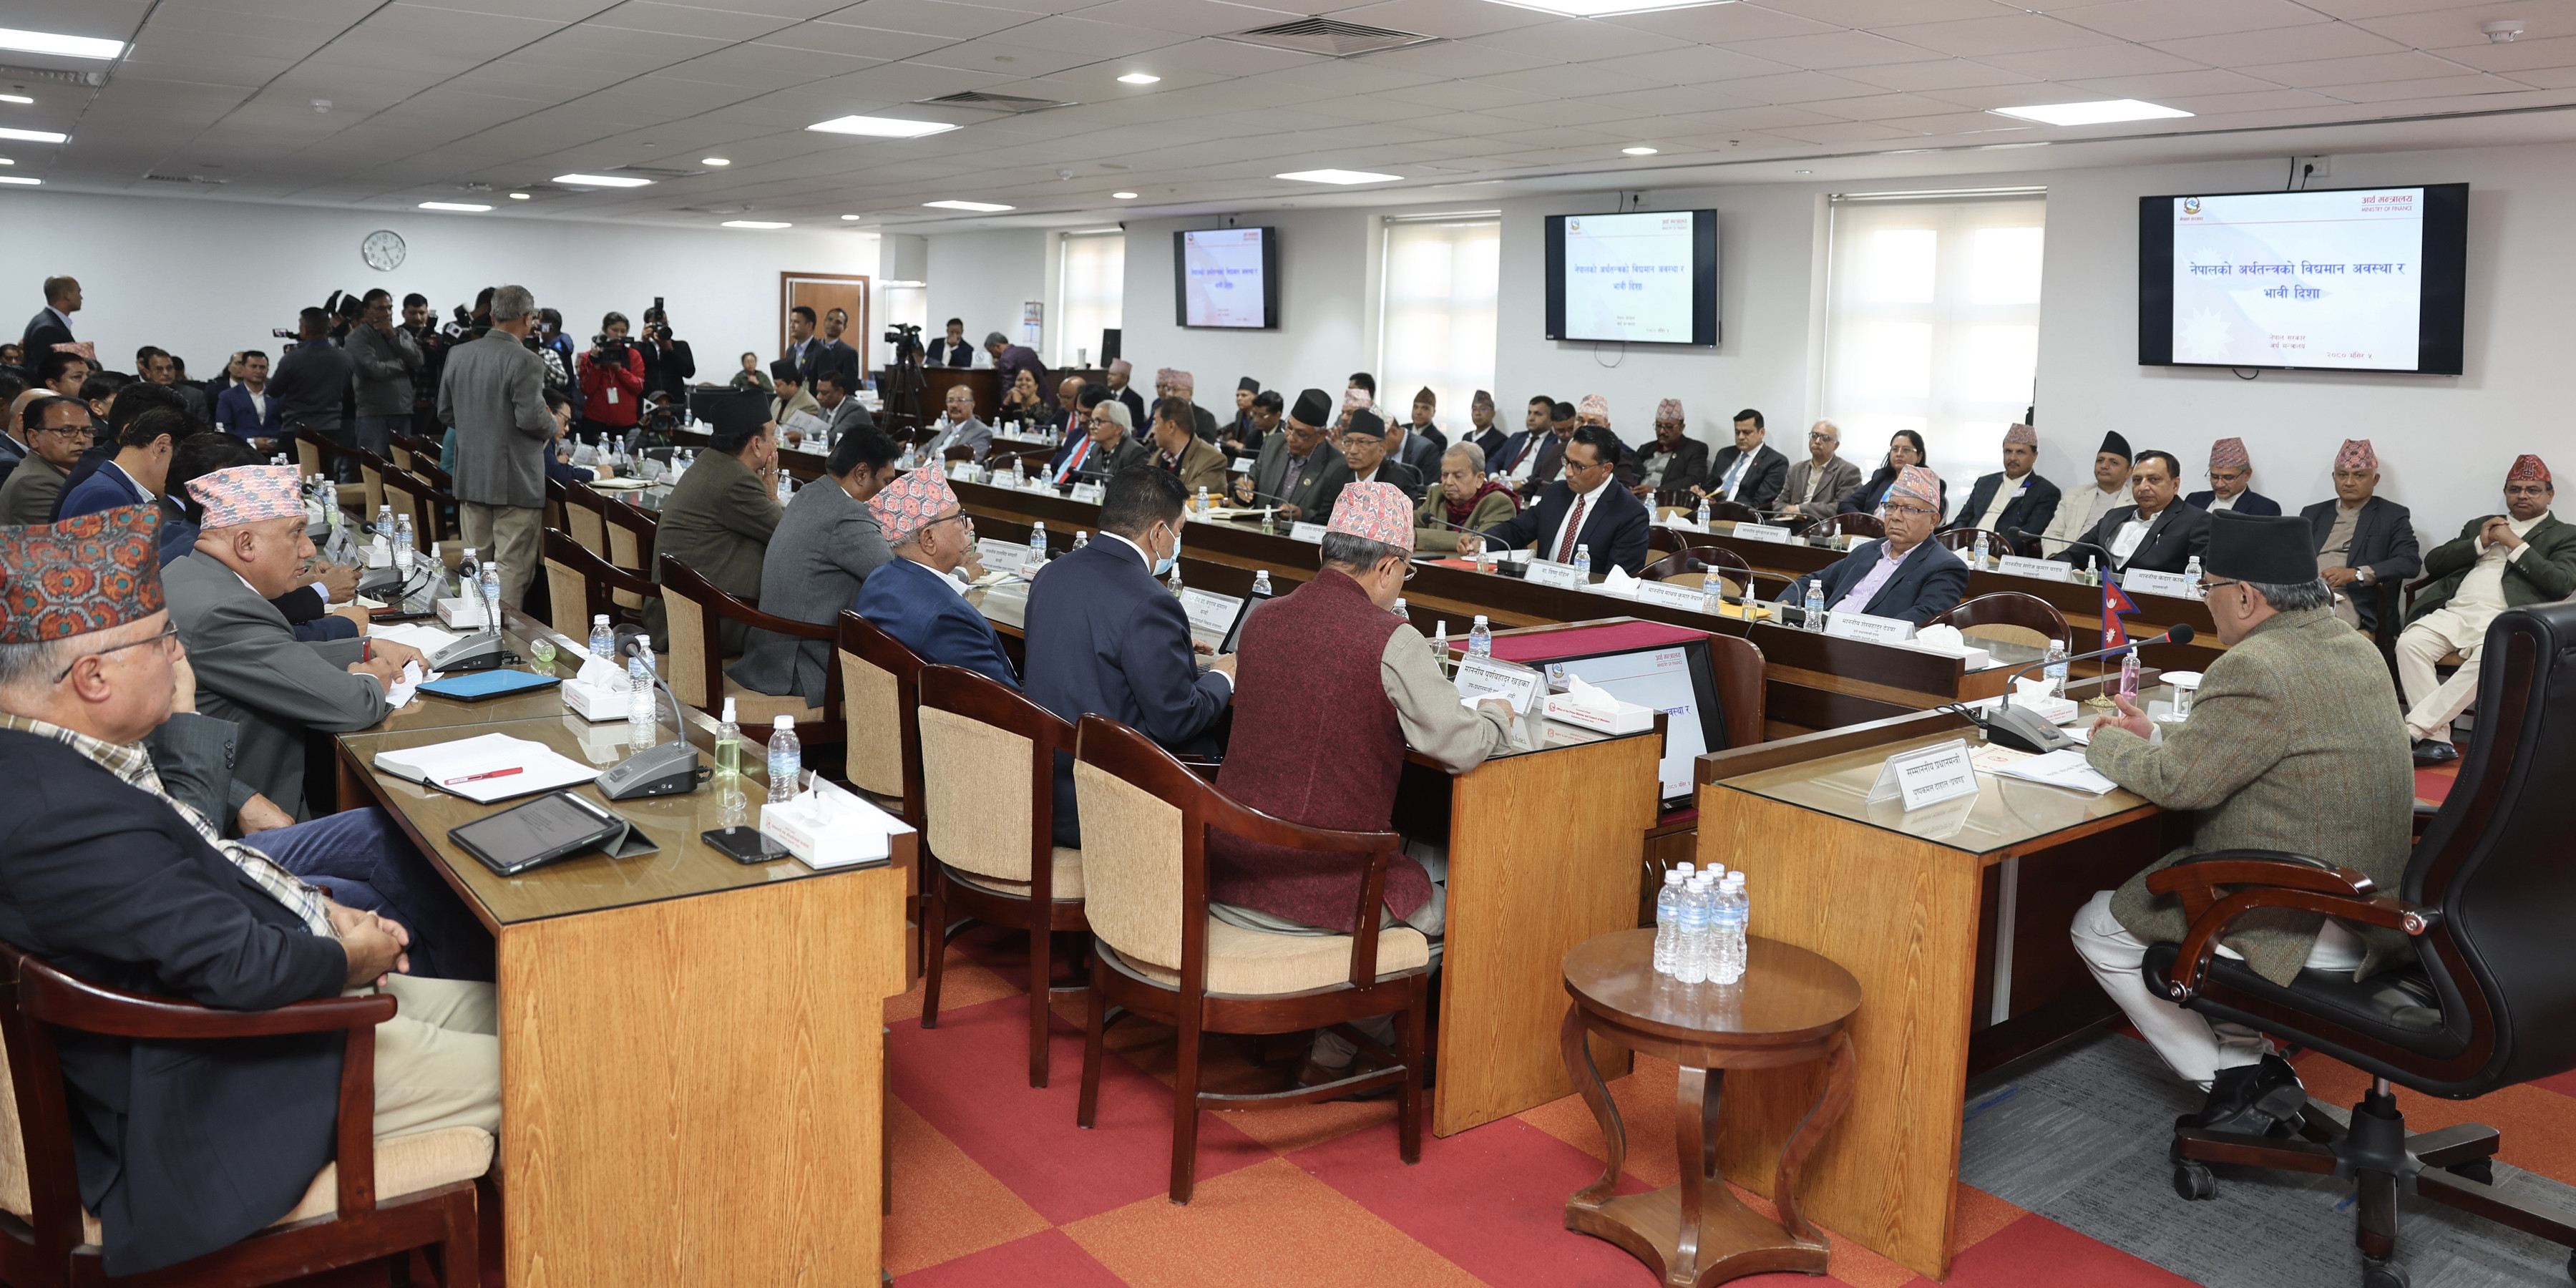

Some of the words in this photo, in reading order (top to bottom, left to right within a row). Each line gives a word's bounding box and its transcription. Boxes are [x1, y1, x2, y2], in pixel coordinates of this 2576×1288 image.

[2361, 195, 2376, 204] अर्थ
[2190, 261, 2232, 275] नेपालको
[2238, 260, 2296, 275] अर्थतन्त्रको
[2301, 260, 2346, 275] विद्यमान
[2352, 263, 2393, 275] अवस्था
[2396, 263, 2406, 275] र
[2263, 285, 2289, 299] भावी
[2294, 284, 2321, 300] दिशा
[2269, 333, 2284, 341] नेपाल
[1690, 593, 1704, 602] नेपाल
[1883, 623, 1896, 633] देउवा
[1464, 665, 1485, 678] माननीय
[1511, 677, 1531, 690] खड्का
[1684, 705, 1691, 714] र
[1906, 761, 1934, 776] सम्माननीय
[1934, 753, 1961, 769] प्रधानमन्त्री
[1913, 784, 1935, 801] पुष्पकमल
[1934, 780, 1948, 791] दाहाल
